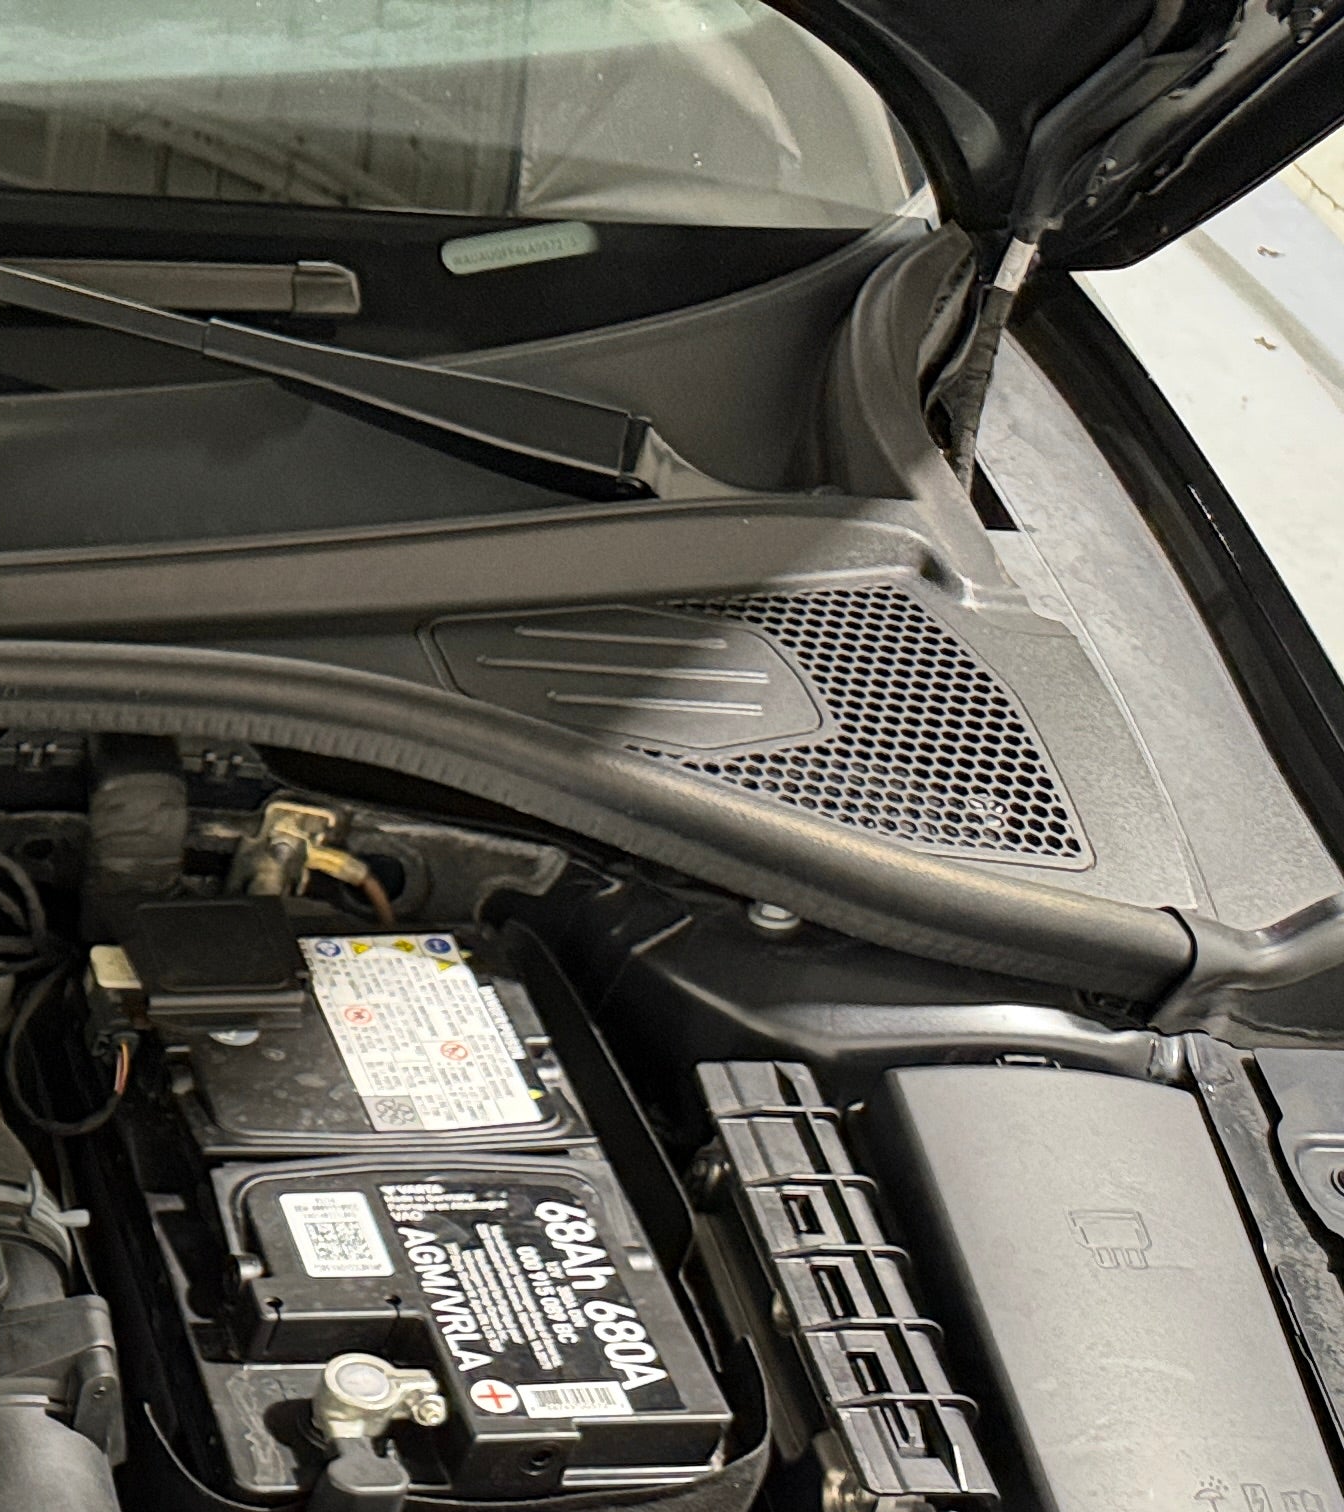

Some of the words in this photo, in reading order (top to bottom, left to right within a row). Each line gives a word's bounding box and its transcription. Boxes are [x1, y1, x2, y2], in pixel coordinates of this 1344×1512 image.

[397, 1226, 494, 1373] AGM/VRLA
[535, 1200, 616, 1291] 68Ah
[583, 1300, 668, 1391] 680A
